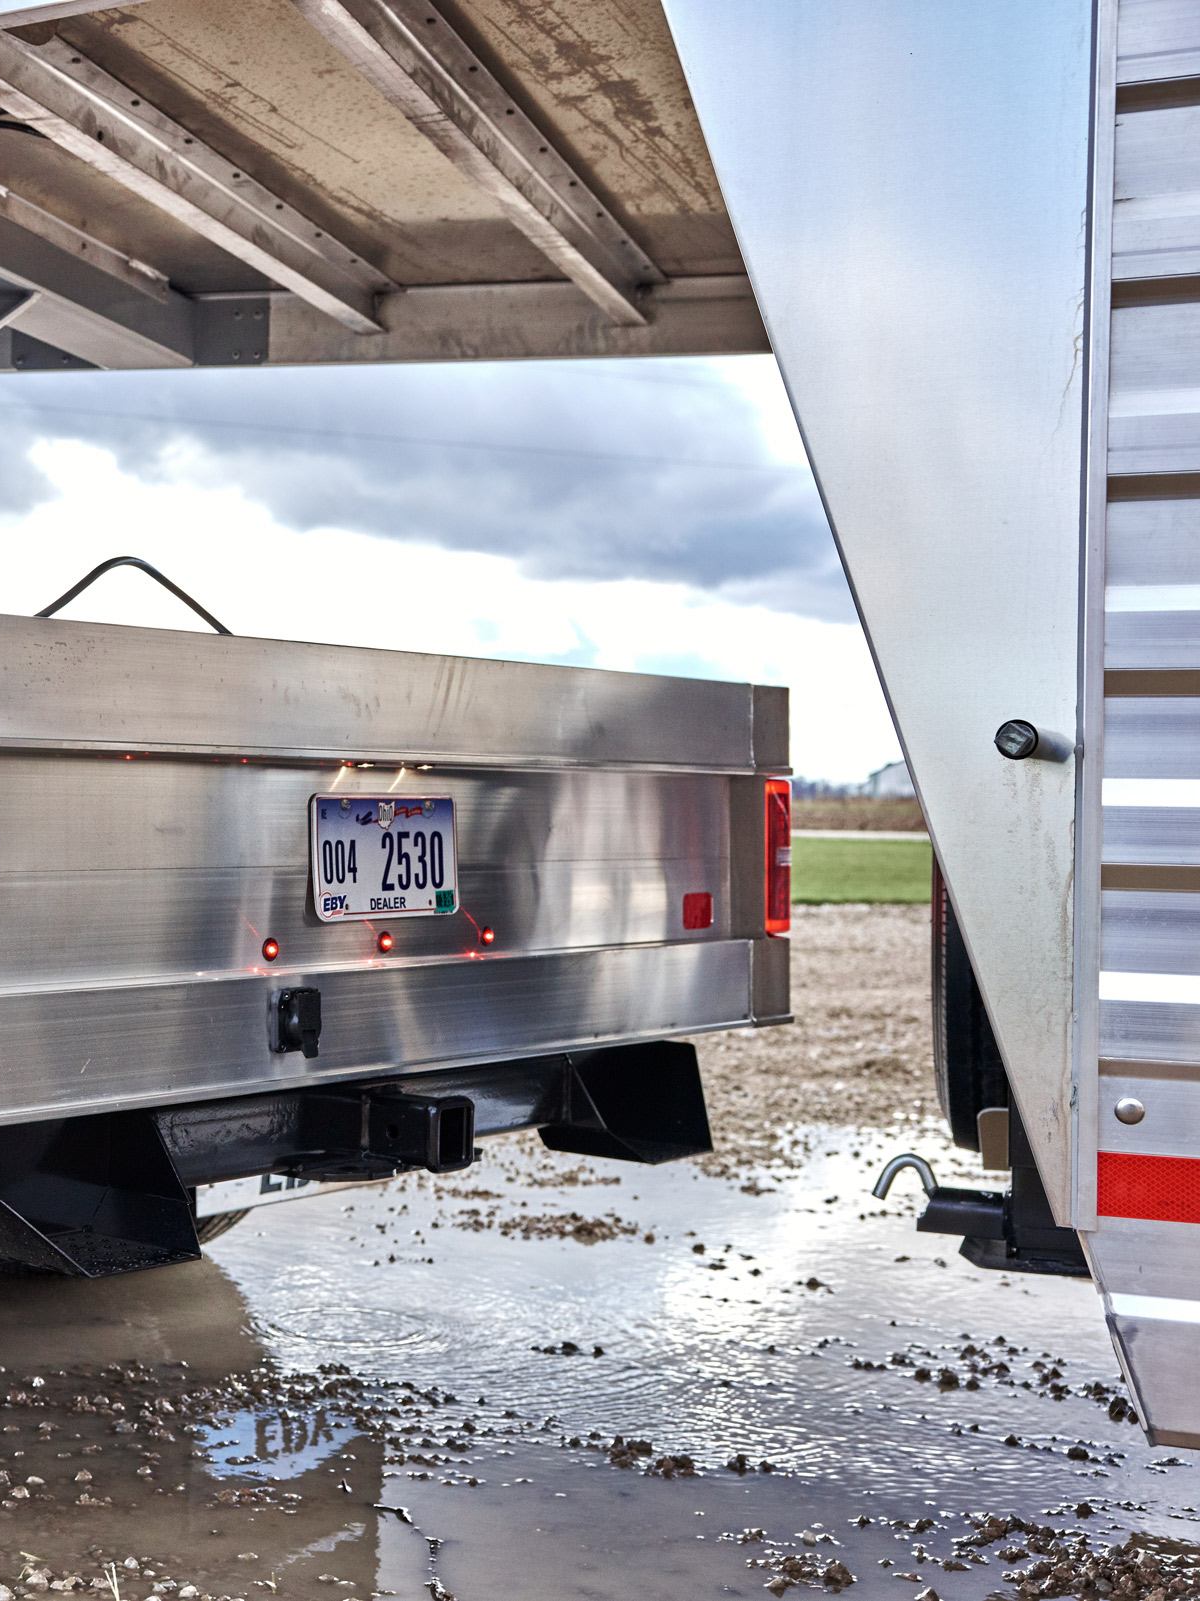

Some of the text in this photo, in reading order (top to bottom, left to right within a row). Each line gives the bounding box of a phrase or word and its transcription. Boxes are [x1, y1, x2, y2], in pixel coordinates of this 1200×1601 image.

[322, 830, 445, 891] 004 2530
[323, 895, 347, 912] EBY
[370, 897, 407, 911] DEALER
